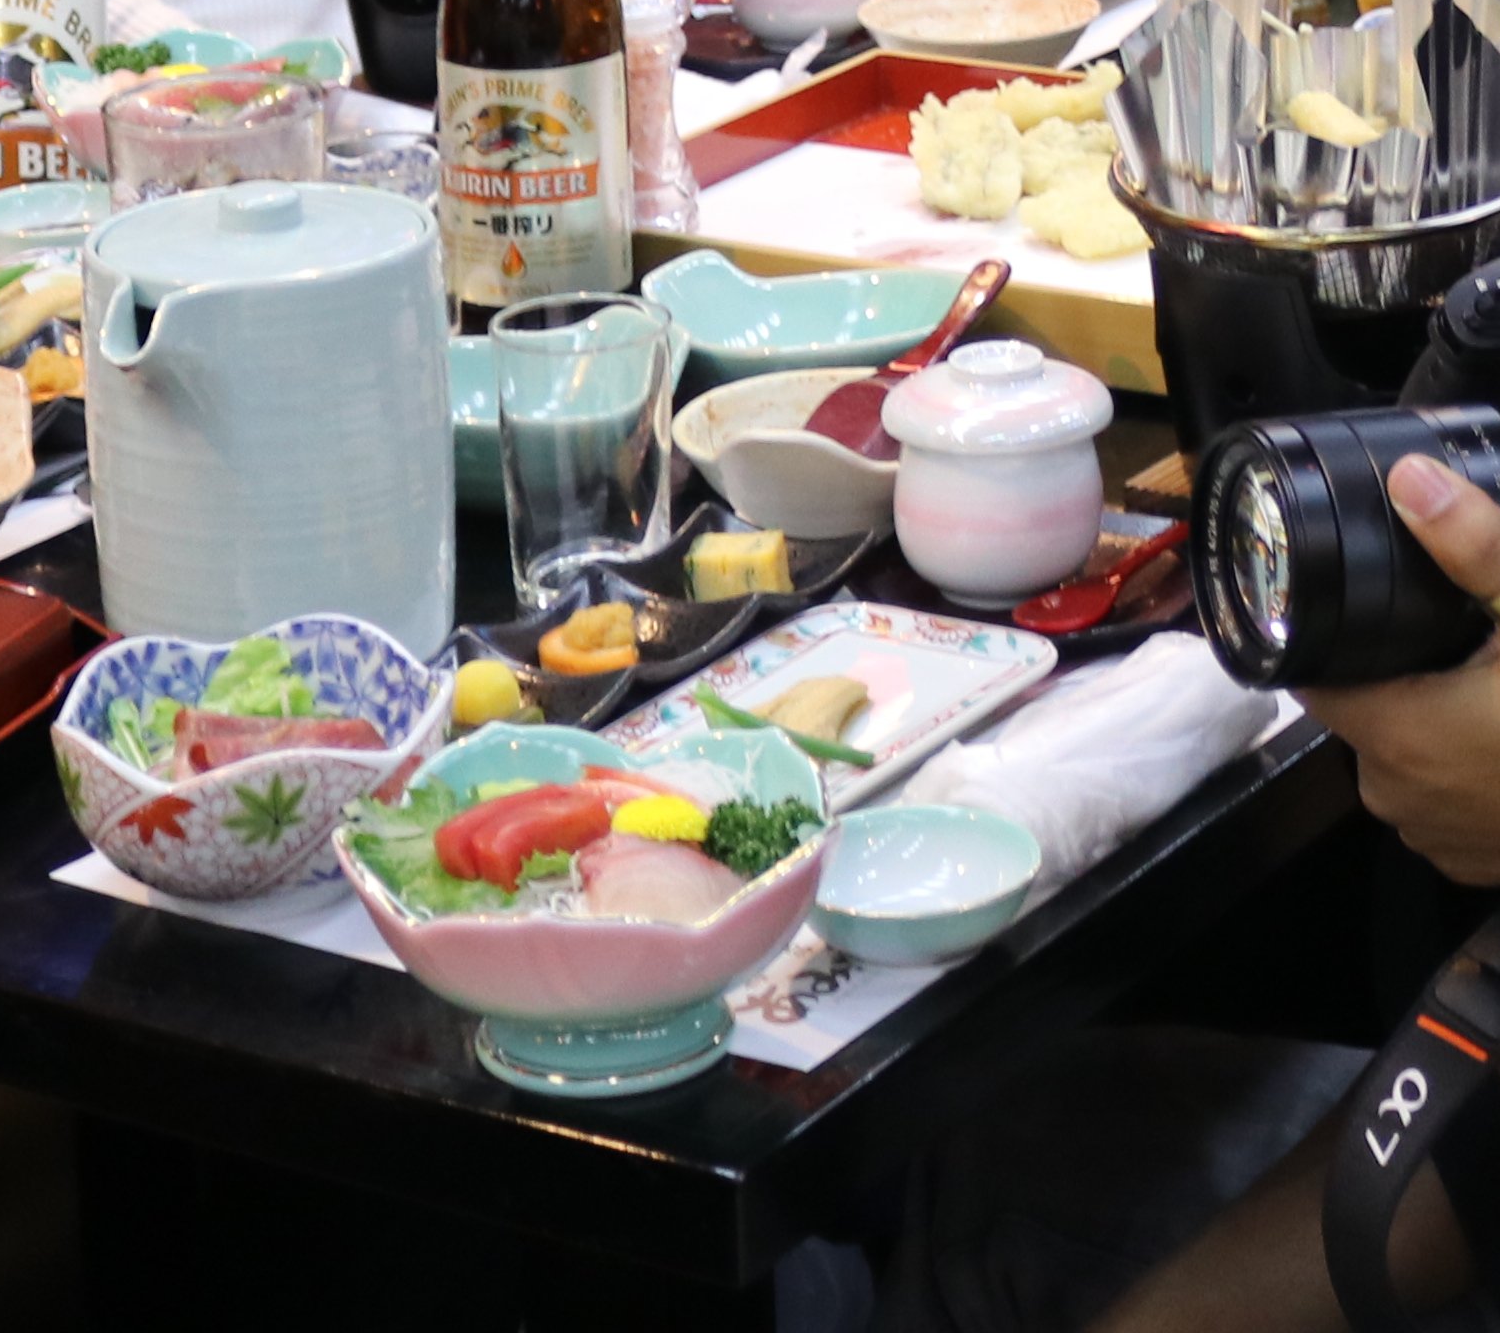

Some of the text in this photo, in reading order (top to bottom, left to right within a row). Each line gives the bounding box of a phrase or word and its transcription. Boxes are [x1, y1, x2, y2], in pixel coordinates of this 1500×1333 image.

[484, 77, 546, 102] PRIME
[17, 140, 107, 183] BEE
[442, 165, 588, 199] KIRIN BEER
